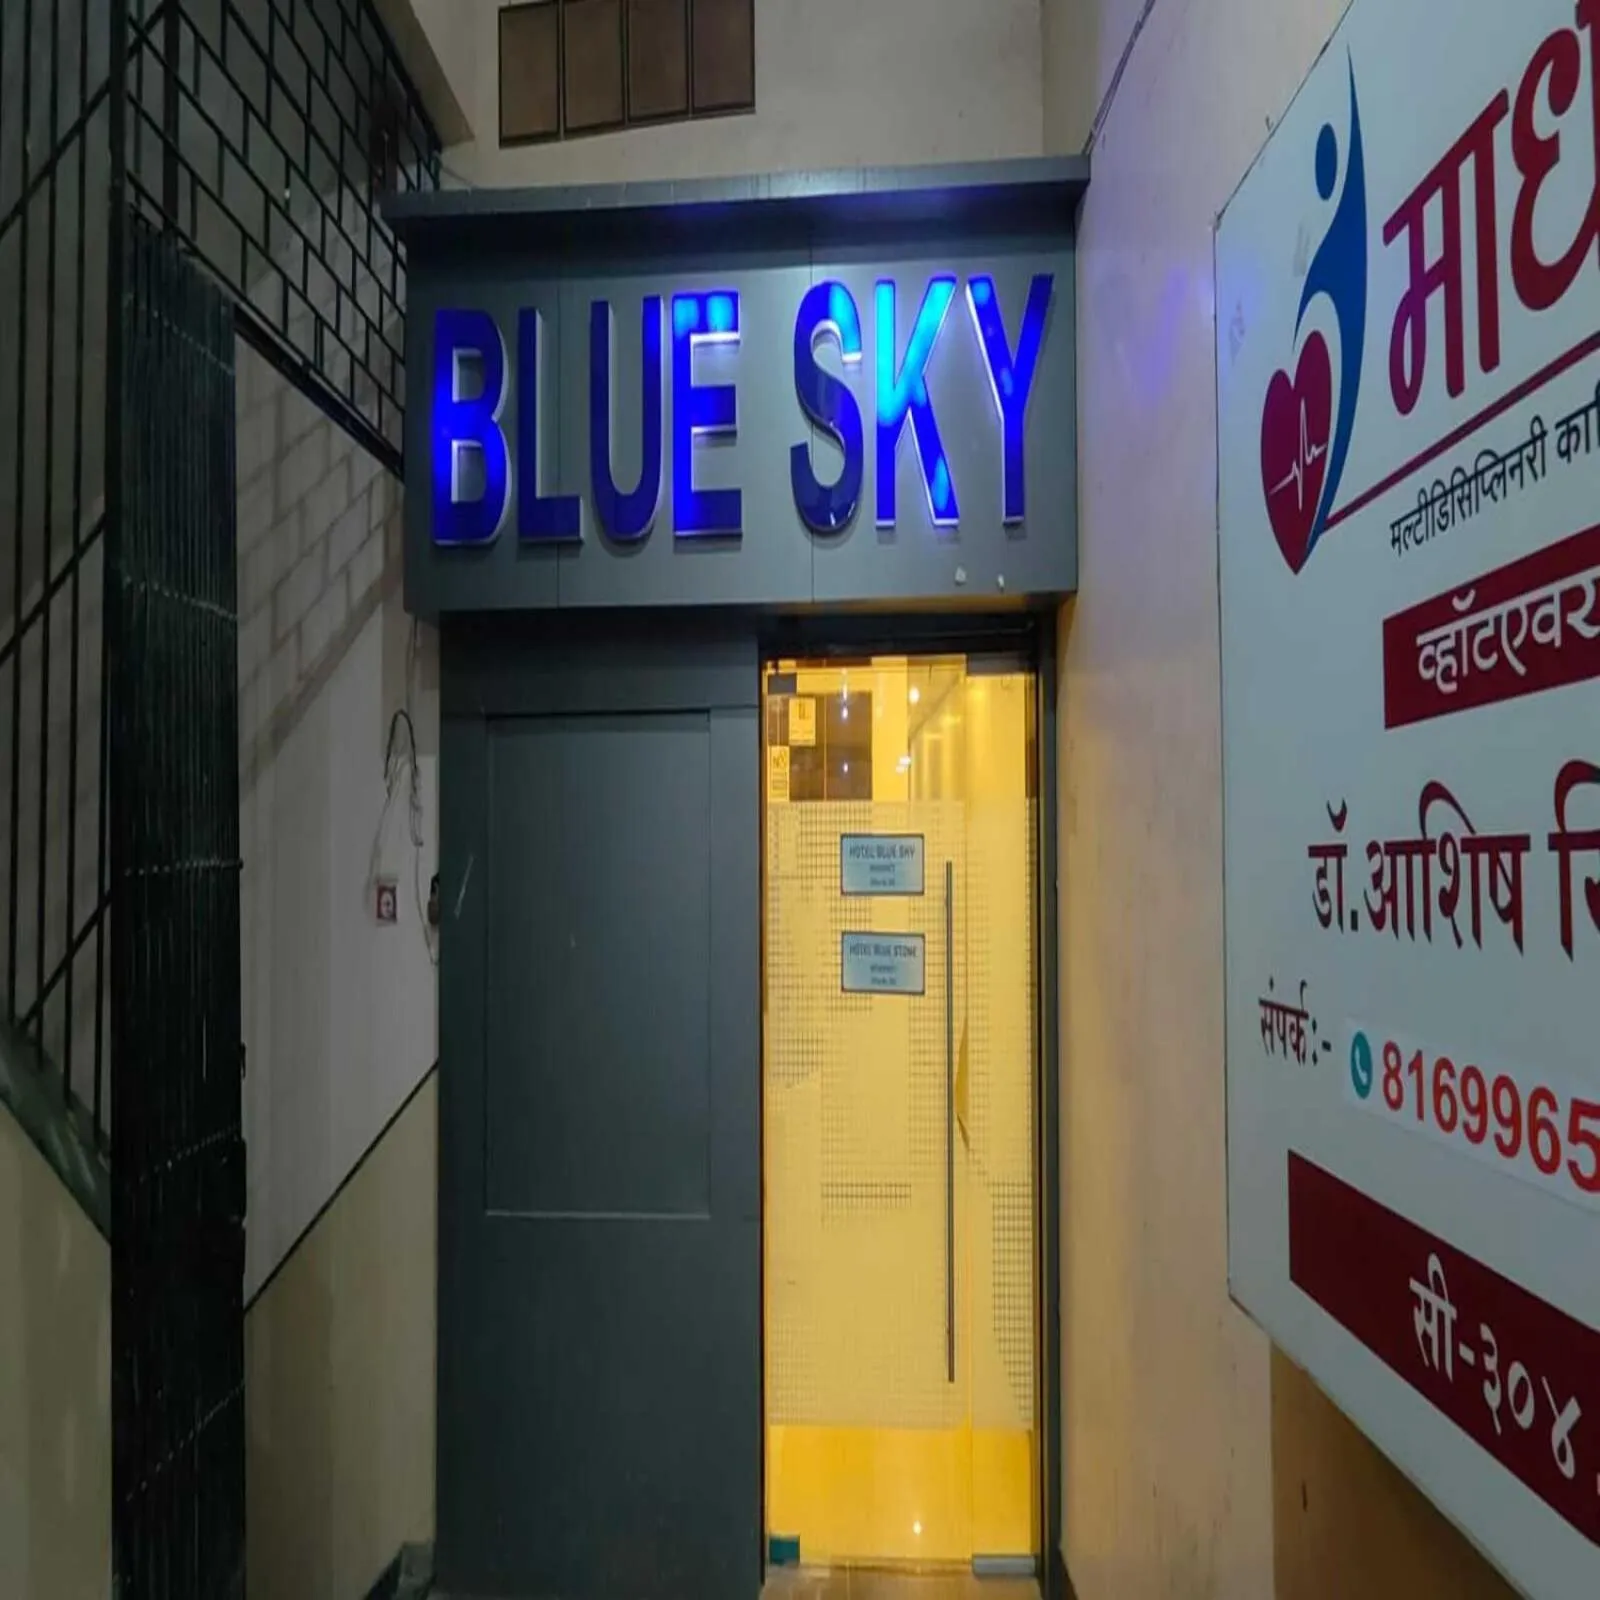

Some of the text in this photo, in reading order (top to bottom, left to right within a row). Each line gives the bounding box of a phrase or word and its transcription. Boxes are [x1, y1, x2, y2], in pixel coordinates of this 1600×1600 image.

[432, 273, 1054, 547] BLUE SKY
[1389, 413, 1549, 557] मल्टीडिसिप्लिनरी
[1382, 1040, 1600, 1194] 8169965
